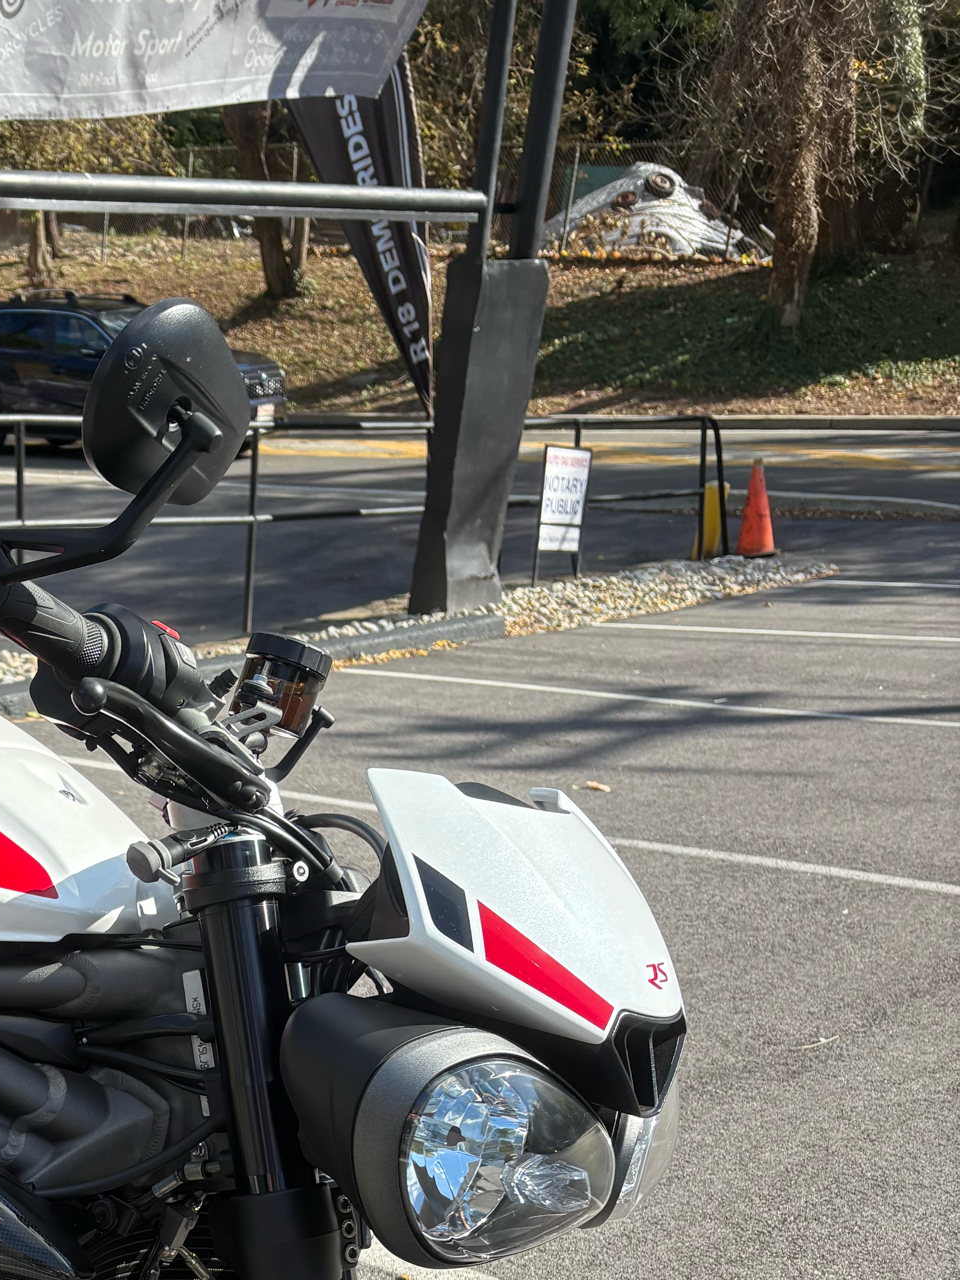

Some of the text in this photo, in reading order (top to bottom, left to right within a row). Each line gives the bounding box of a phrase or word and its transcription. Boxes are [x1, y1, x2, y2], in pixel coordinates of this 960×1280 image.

[71, 31, 130, 58] Motor
[134, 29, 184, 62] Sport
[371, 219, 407, 295] DEM
[397, 301, 428, 365] R18
[544, 475, 586, 494] NOTARY
[544, 498, 580, 515] PUBLIC
[645, 961, 668, 990] RS
